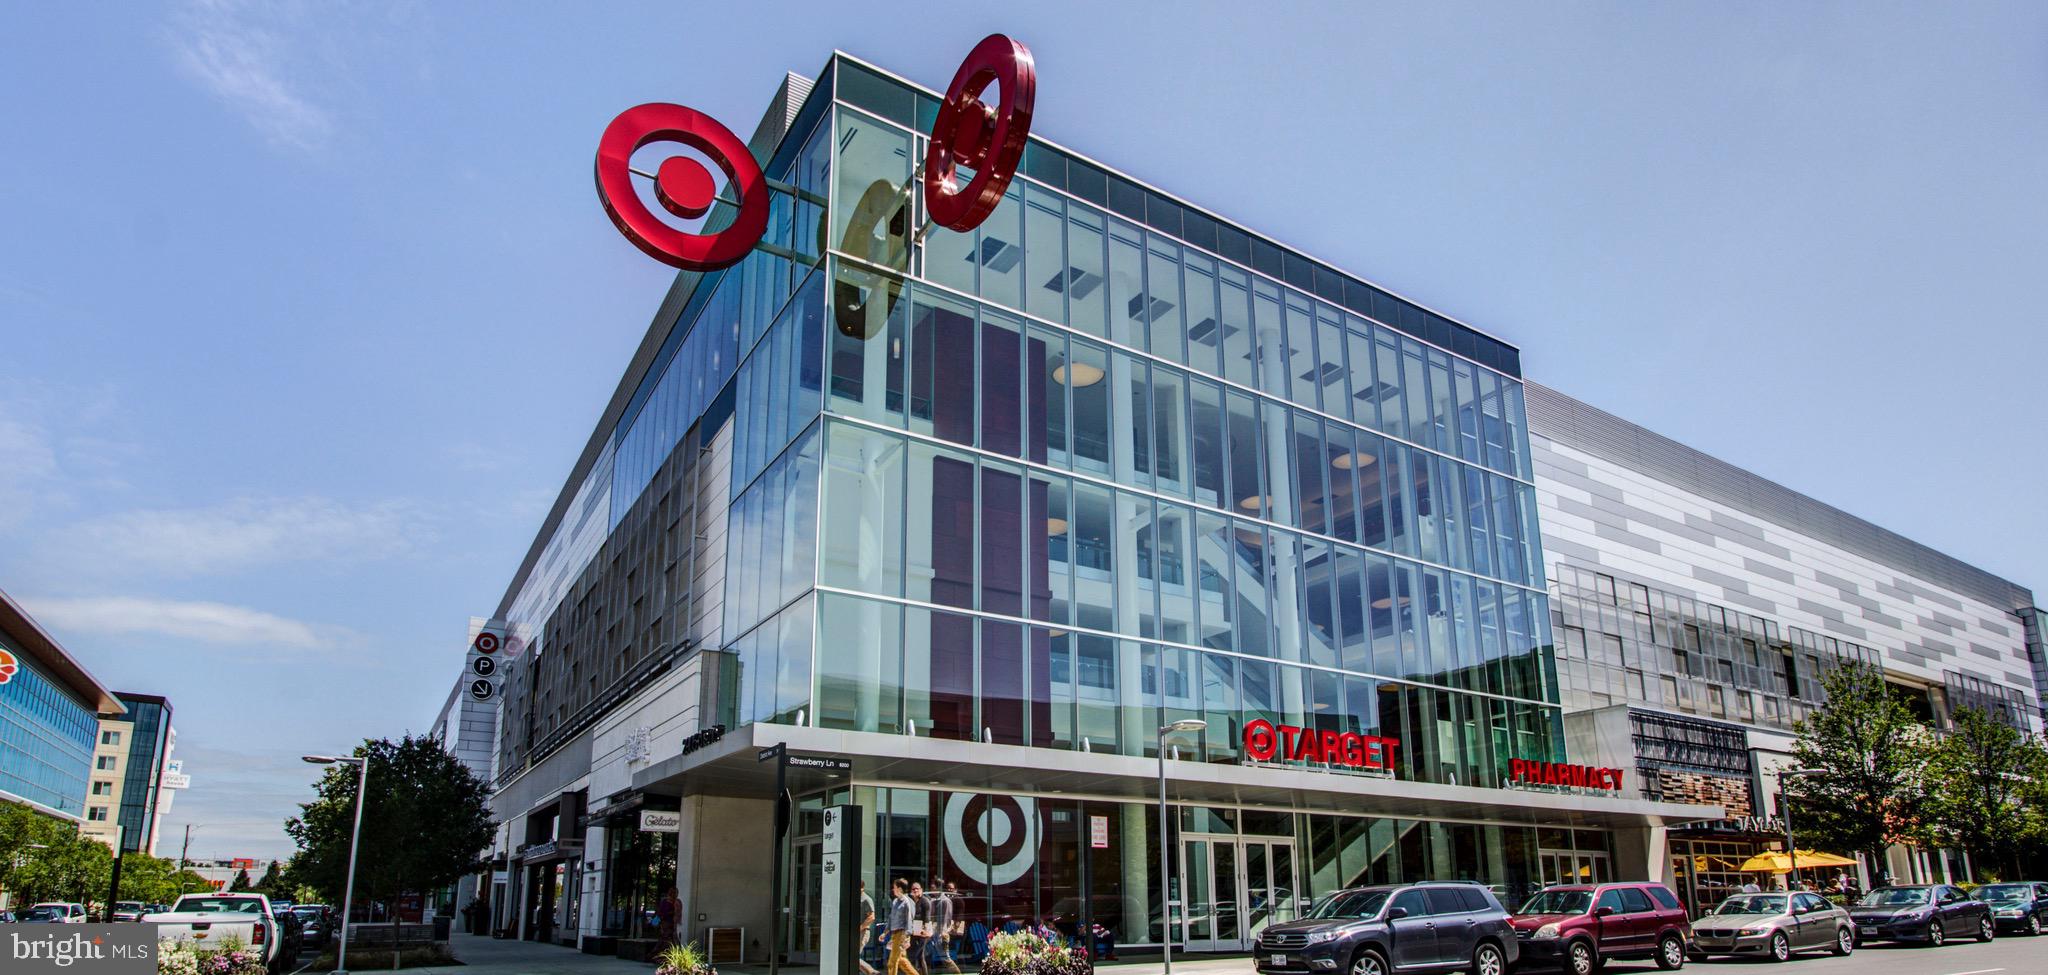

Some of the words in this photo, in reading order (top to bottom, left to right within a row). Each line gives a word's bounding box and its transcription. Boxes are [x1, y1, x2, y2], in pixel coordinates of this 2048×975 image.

[479, 660, 490, 671] P
[1276, 724, 1400, 770] TARGET
[790, 757, 825, 767] Strawberry
[1508, 758, 1624, 790] PHARMACY
